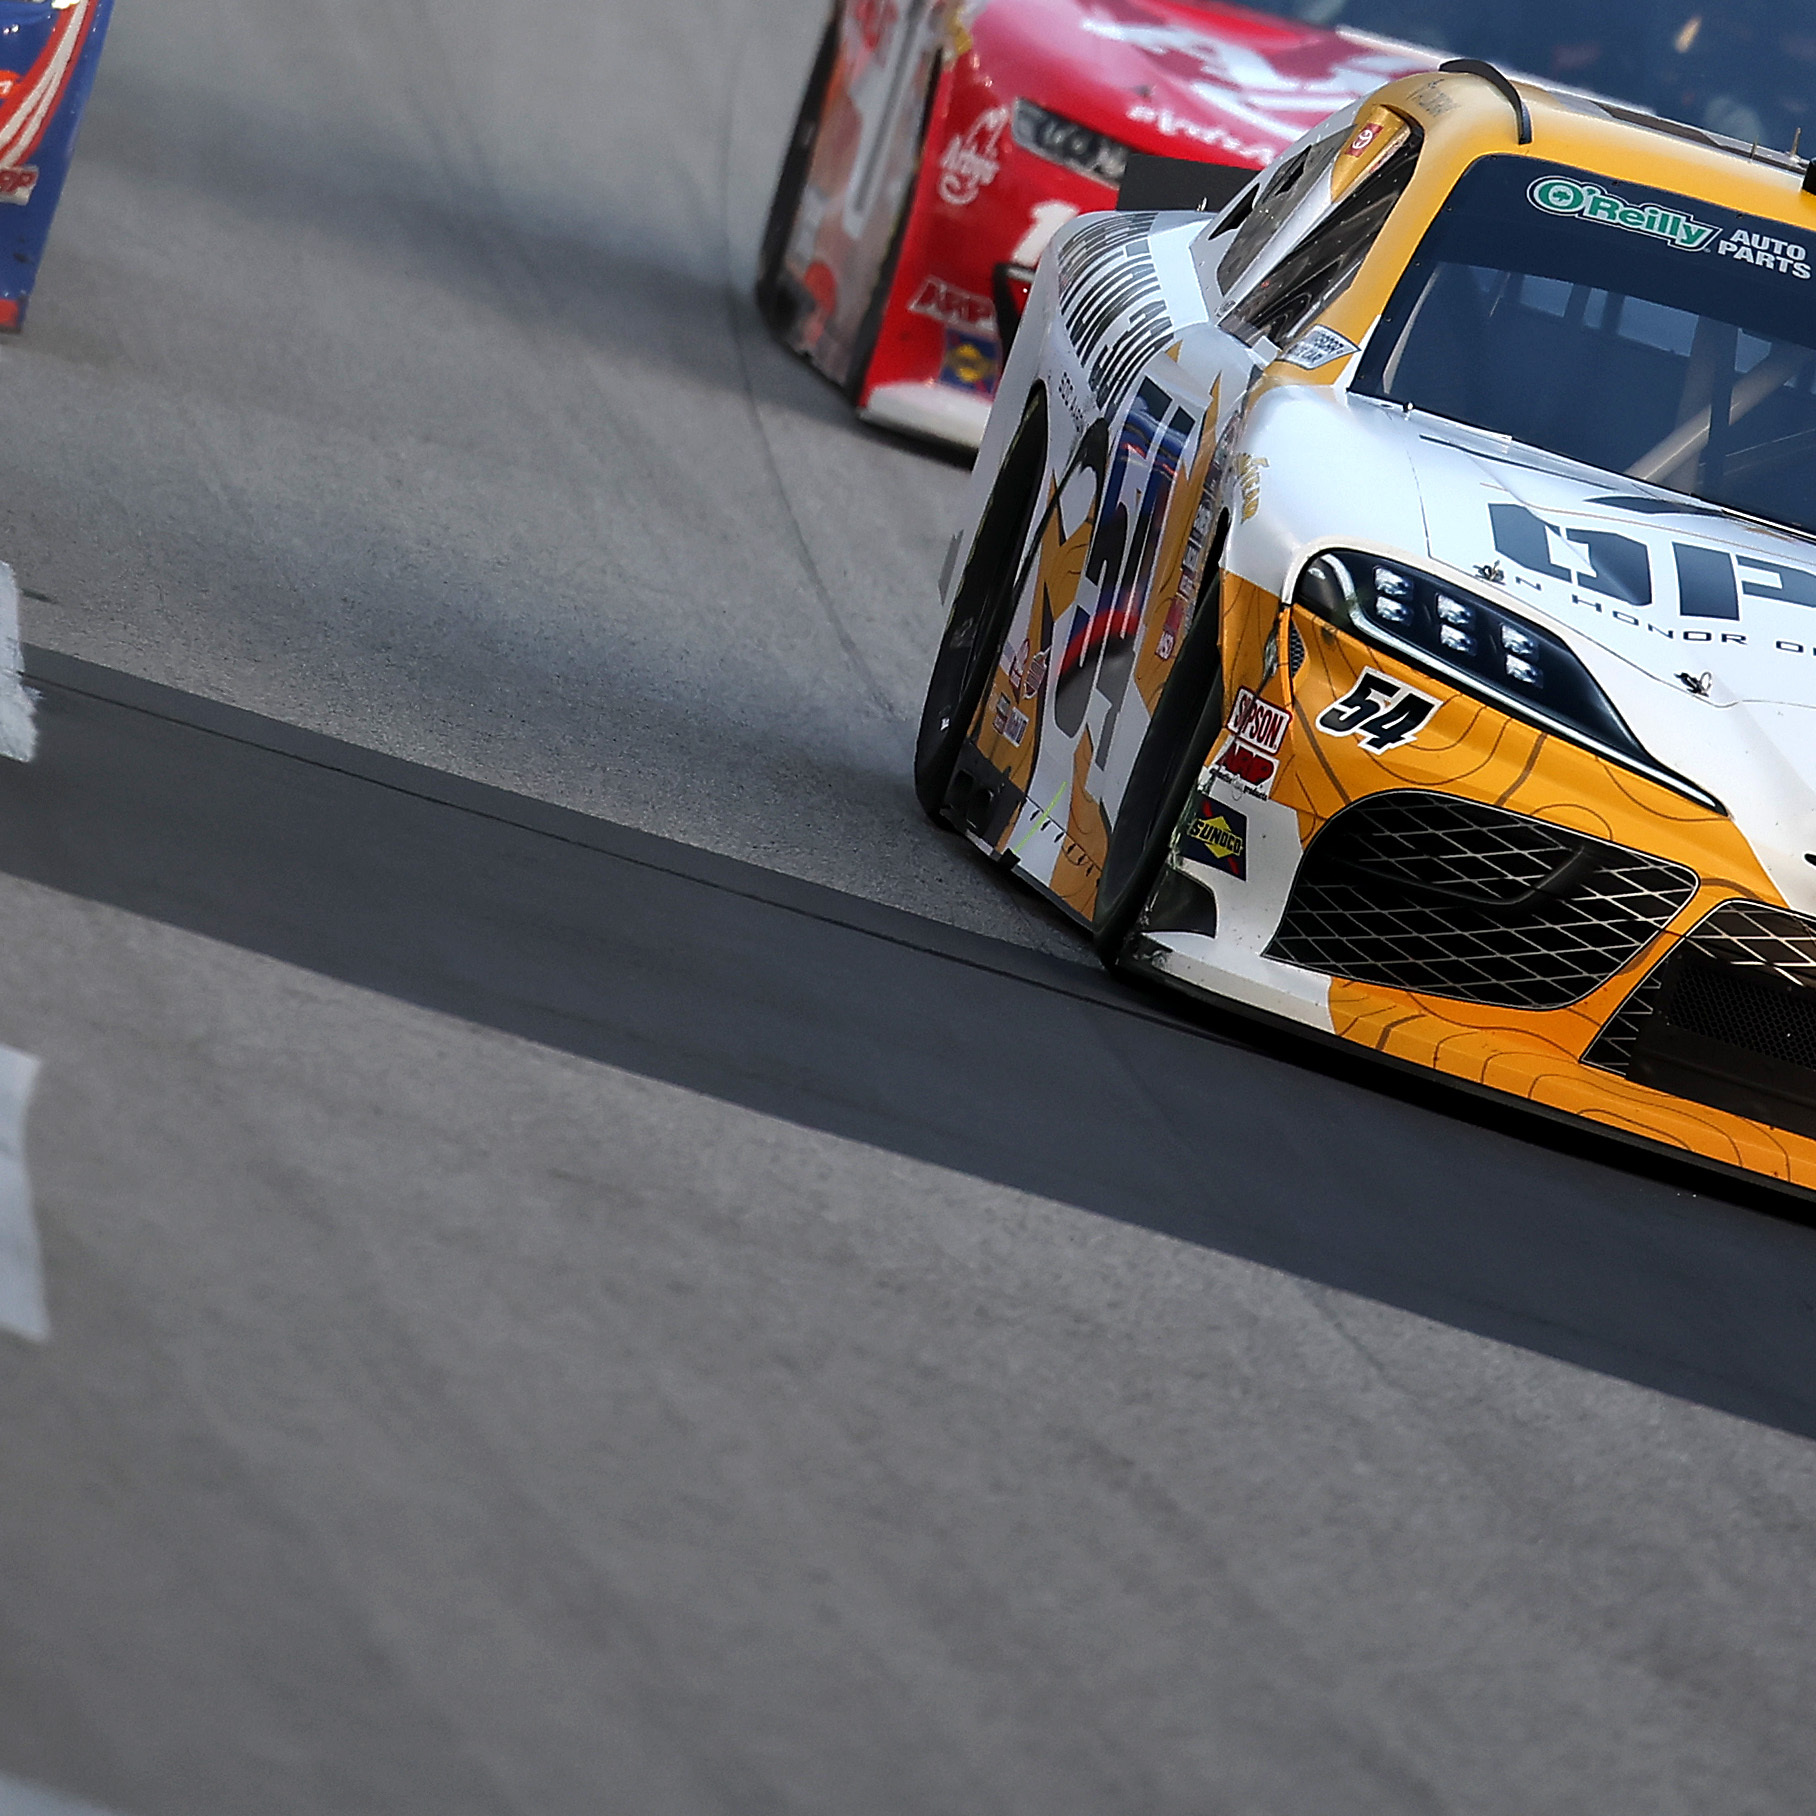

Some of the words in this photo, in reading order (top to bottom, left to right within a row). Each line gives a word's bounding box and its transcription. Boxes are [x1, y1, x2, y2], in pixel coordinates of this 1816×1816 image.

[1528, 176, 1718, 250] O'Reilly
[1717, 239, 1813, 281] PARTS
[1731, 227, 1806, 261] AUTO
[1572, 594, 1748, 645] HONOR
[1316, 667, 1448, 754] 54
[1190, 819, 1244, 857] SUNOCO
